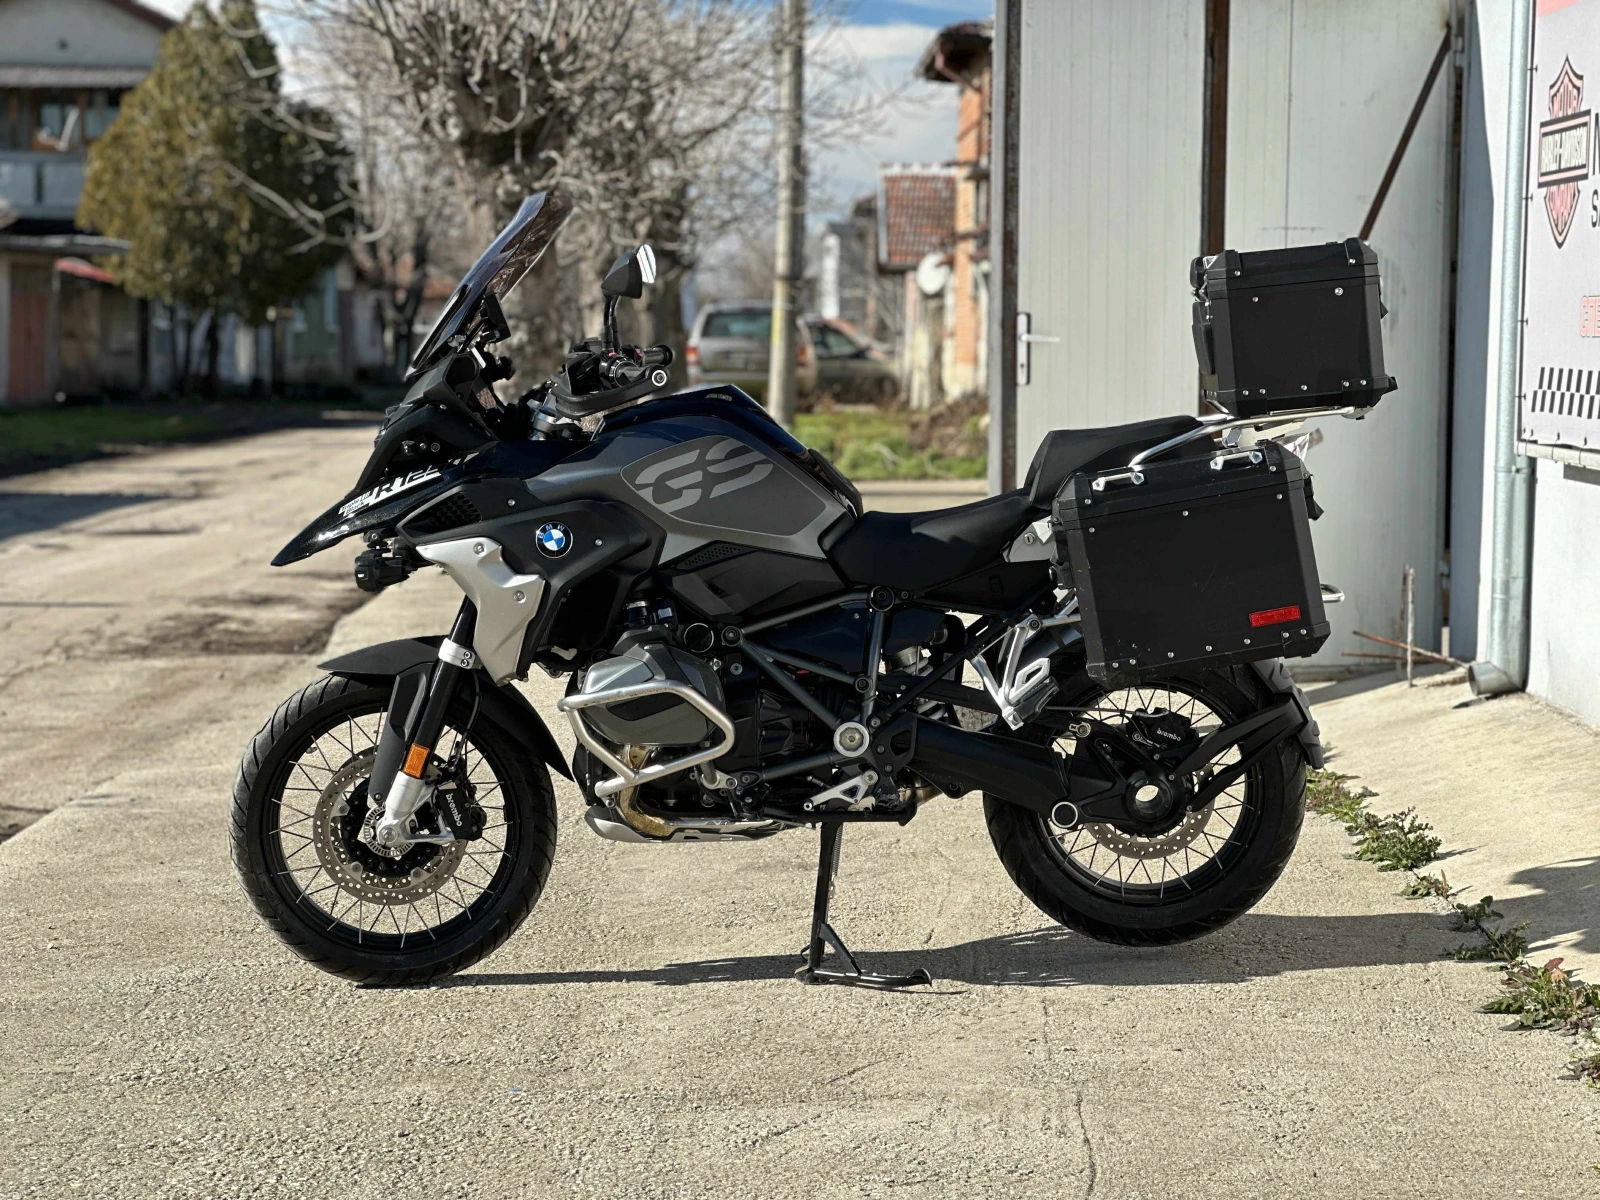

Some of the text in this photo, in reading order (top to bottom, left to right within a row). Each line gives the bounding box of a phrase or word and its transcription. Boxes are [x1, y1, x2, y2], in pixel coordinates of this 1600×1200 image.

[635, 438, 773, 513] GS
[537, 523, 565, 539] BMW
[1156, 727, 1181, 741] brembo
[445, 792, 462, 826] brembo
